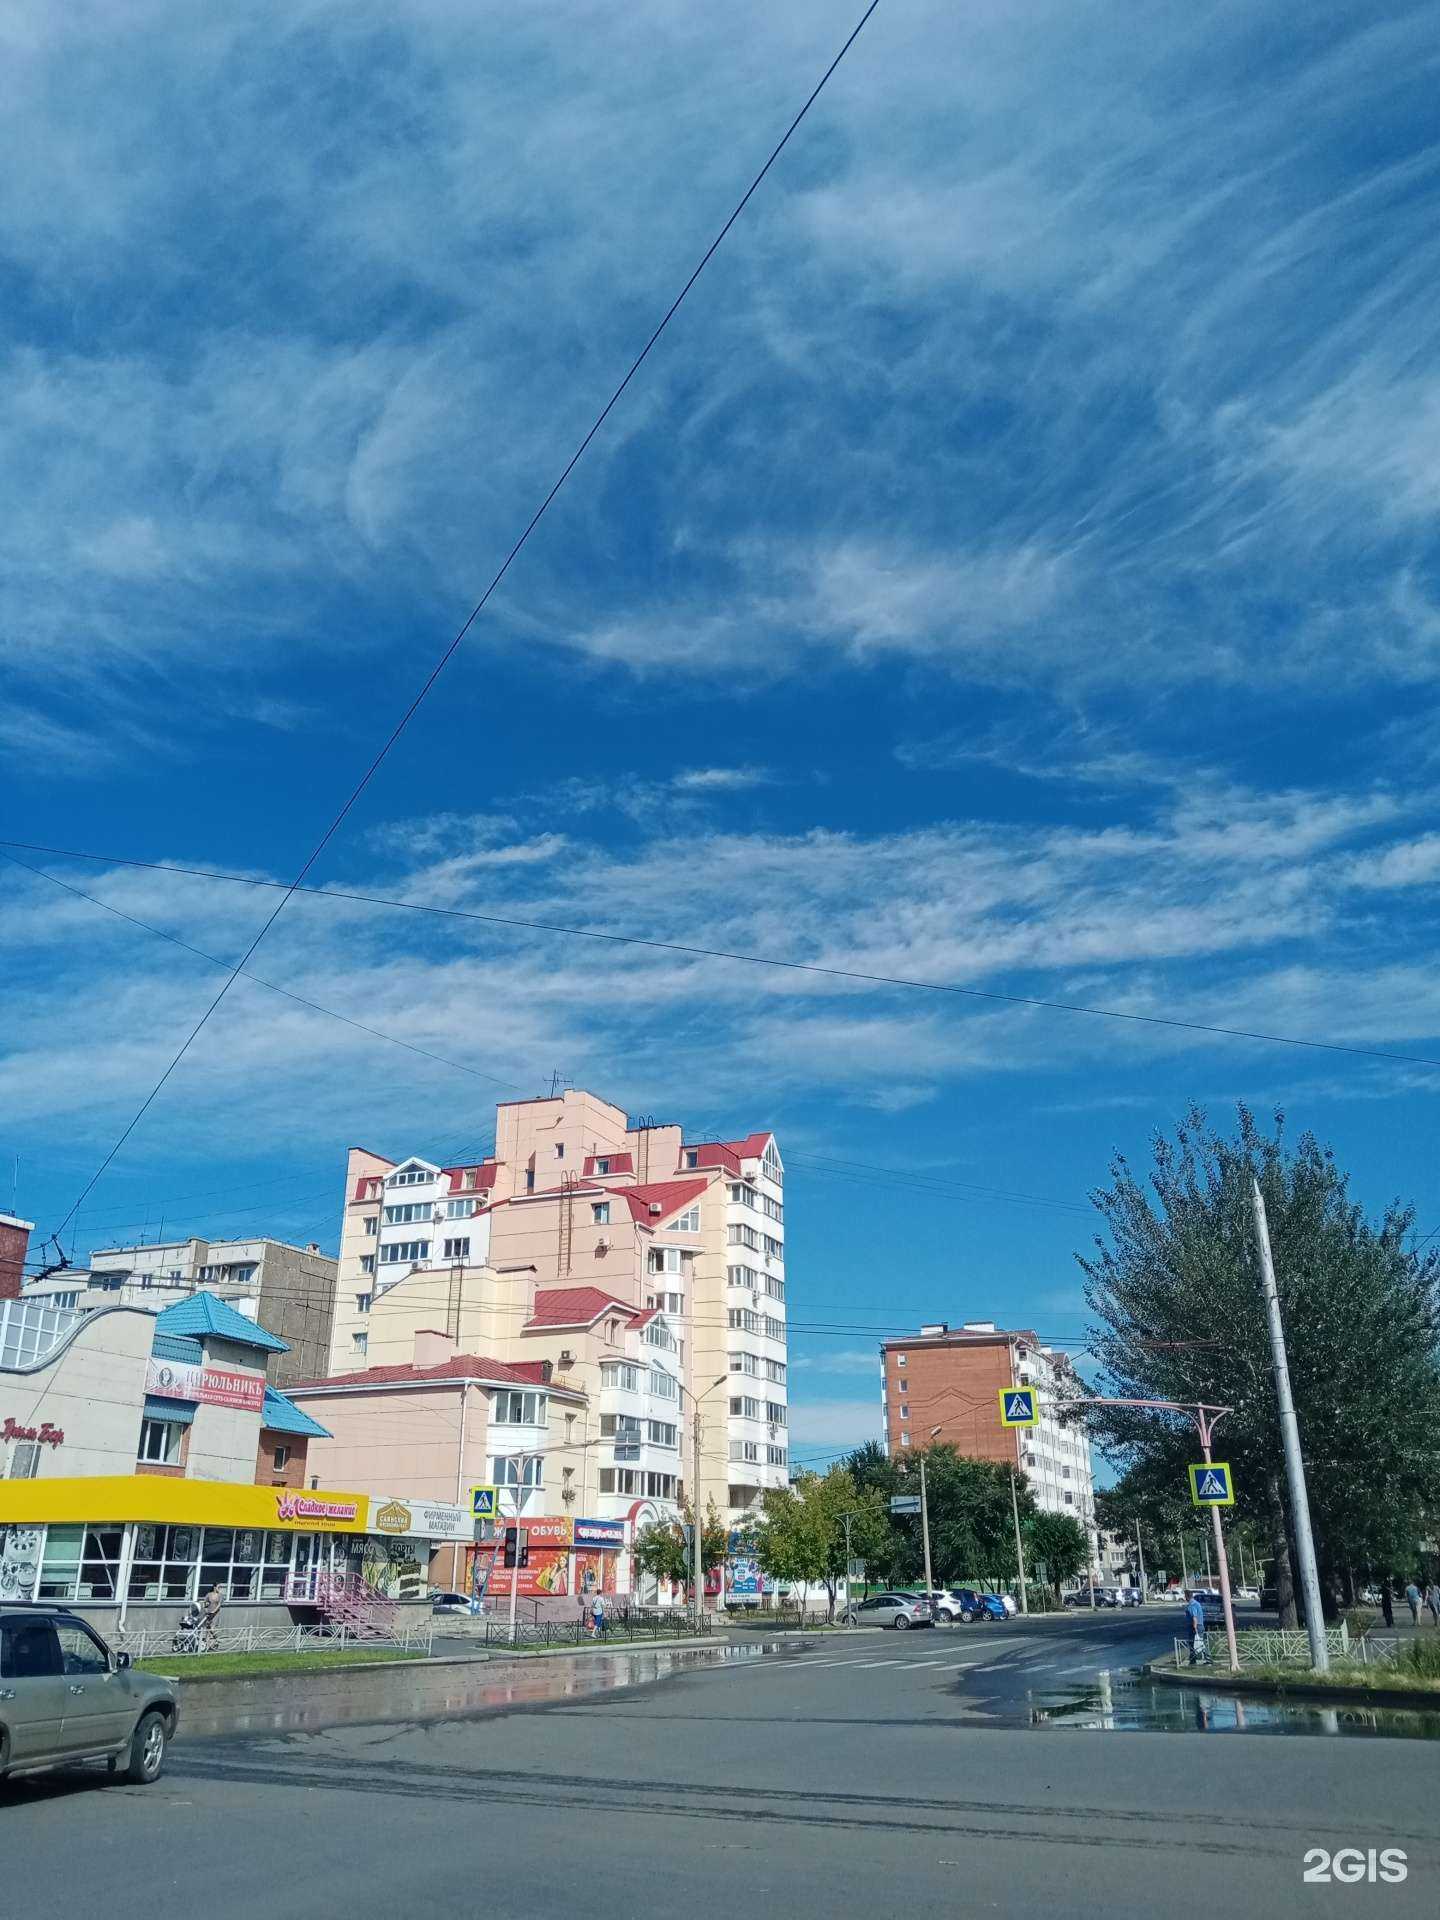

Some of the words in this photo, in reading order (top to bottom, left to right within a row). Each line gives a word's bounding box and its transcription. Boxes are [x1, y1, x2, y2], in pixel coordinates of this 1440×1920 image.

[424, 1509, 461, 1522] ФИРМЕННЫЙ
[429, 1521, 455, 1532] МАГАЗИН
[531, 1525, 567, 1537] ОБУВЬ
[352, 1542, 375, 1554] МЯСО
[393, 1543, 416, 1555] ТОРТЫ
